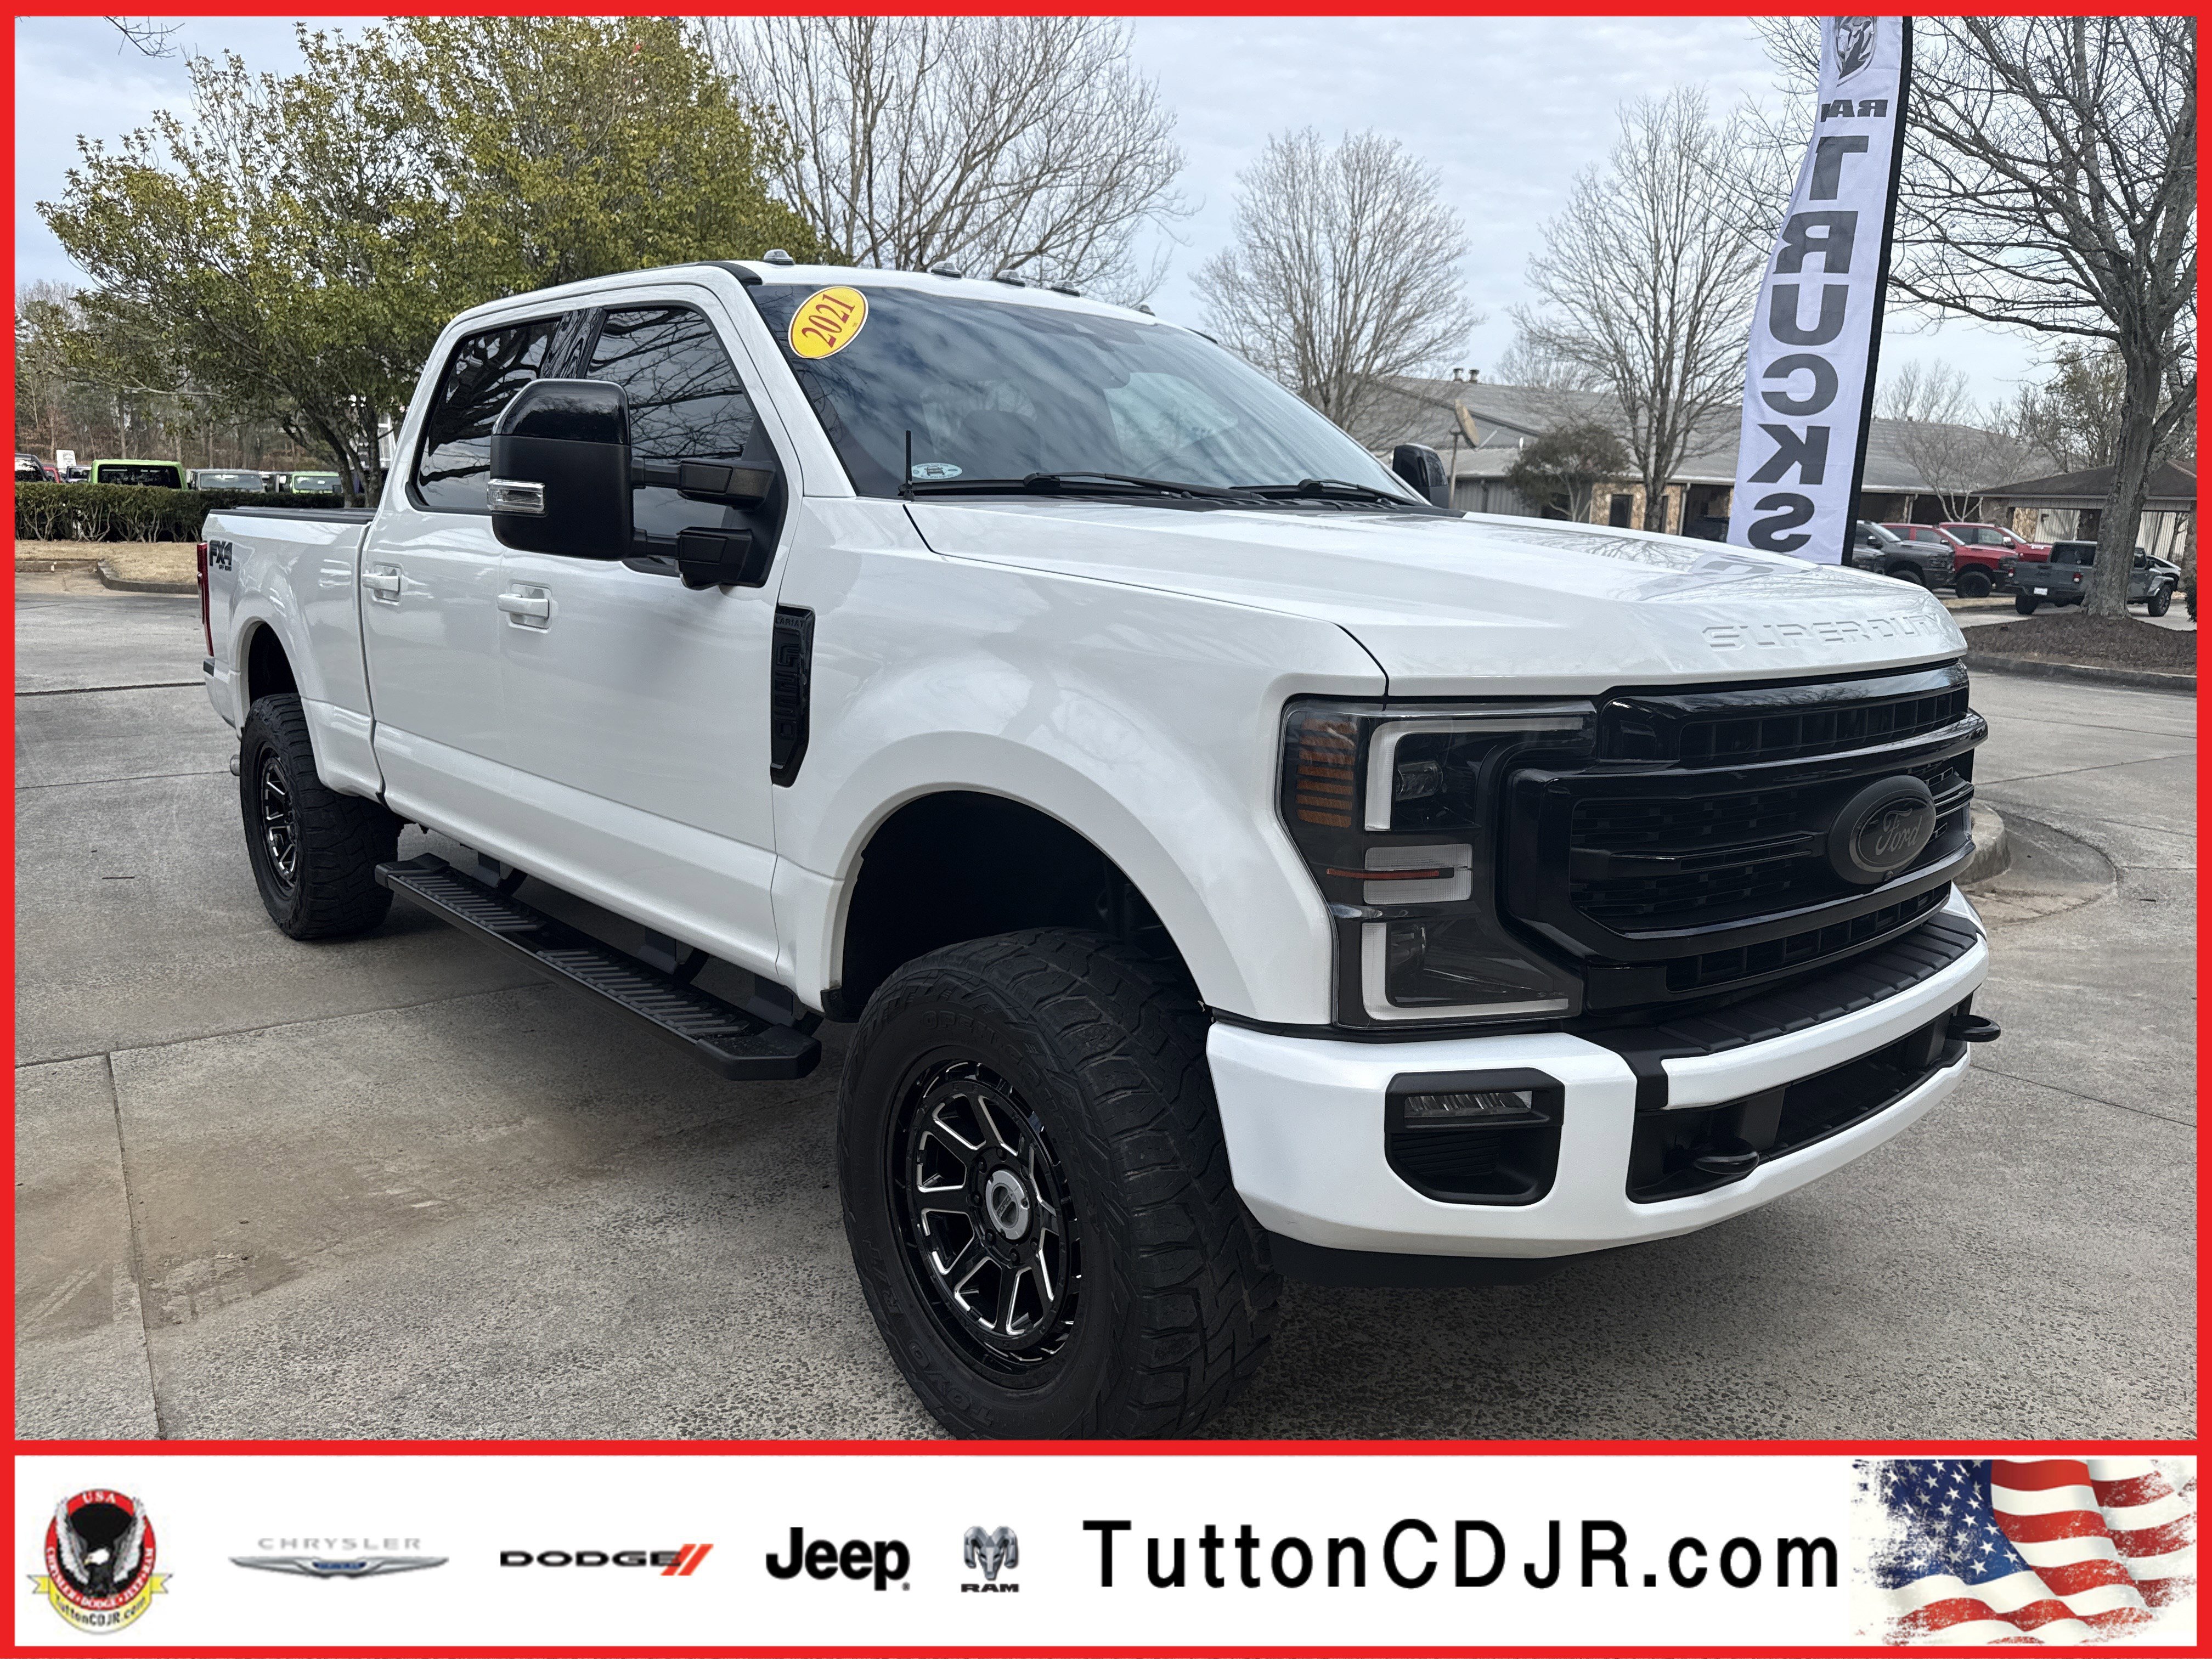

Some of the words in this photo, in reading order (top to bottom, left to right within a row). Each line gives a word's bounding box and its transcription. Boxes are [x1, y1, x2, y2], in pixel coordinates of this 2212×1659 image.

[802, 294, 855, 348] 2021
[210, 540, 233, 567] FX4
[775, 616, 805, 628] LARIAT
[1875, 808, 1923, 856] Ford
[923, 1010, 995, 1045] OPEN
[996, 1194, 1011, 1217] FORD
[907, 1340, 994, 1427] TOYO
